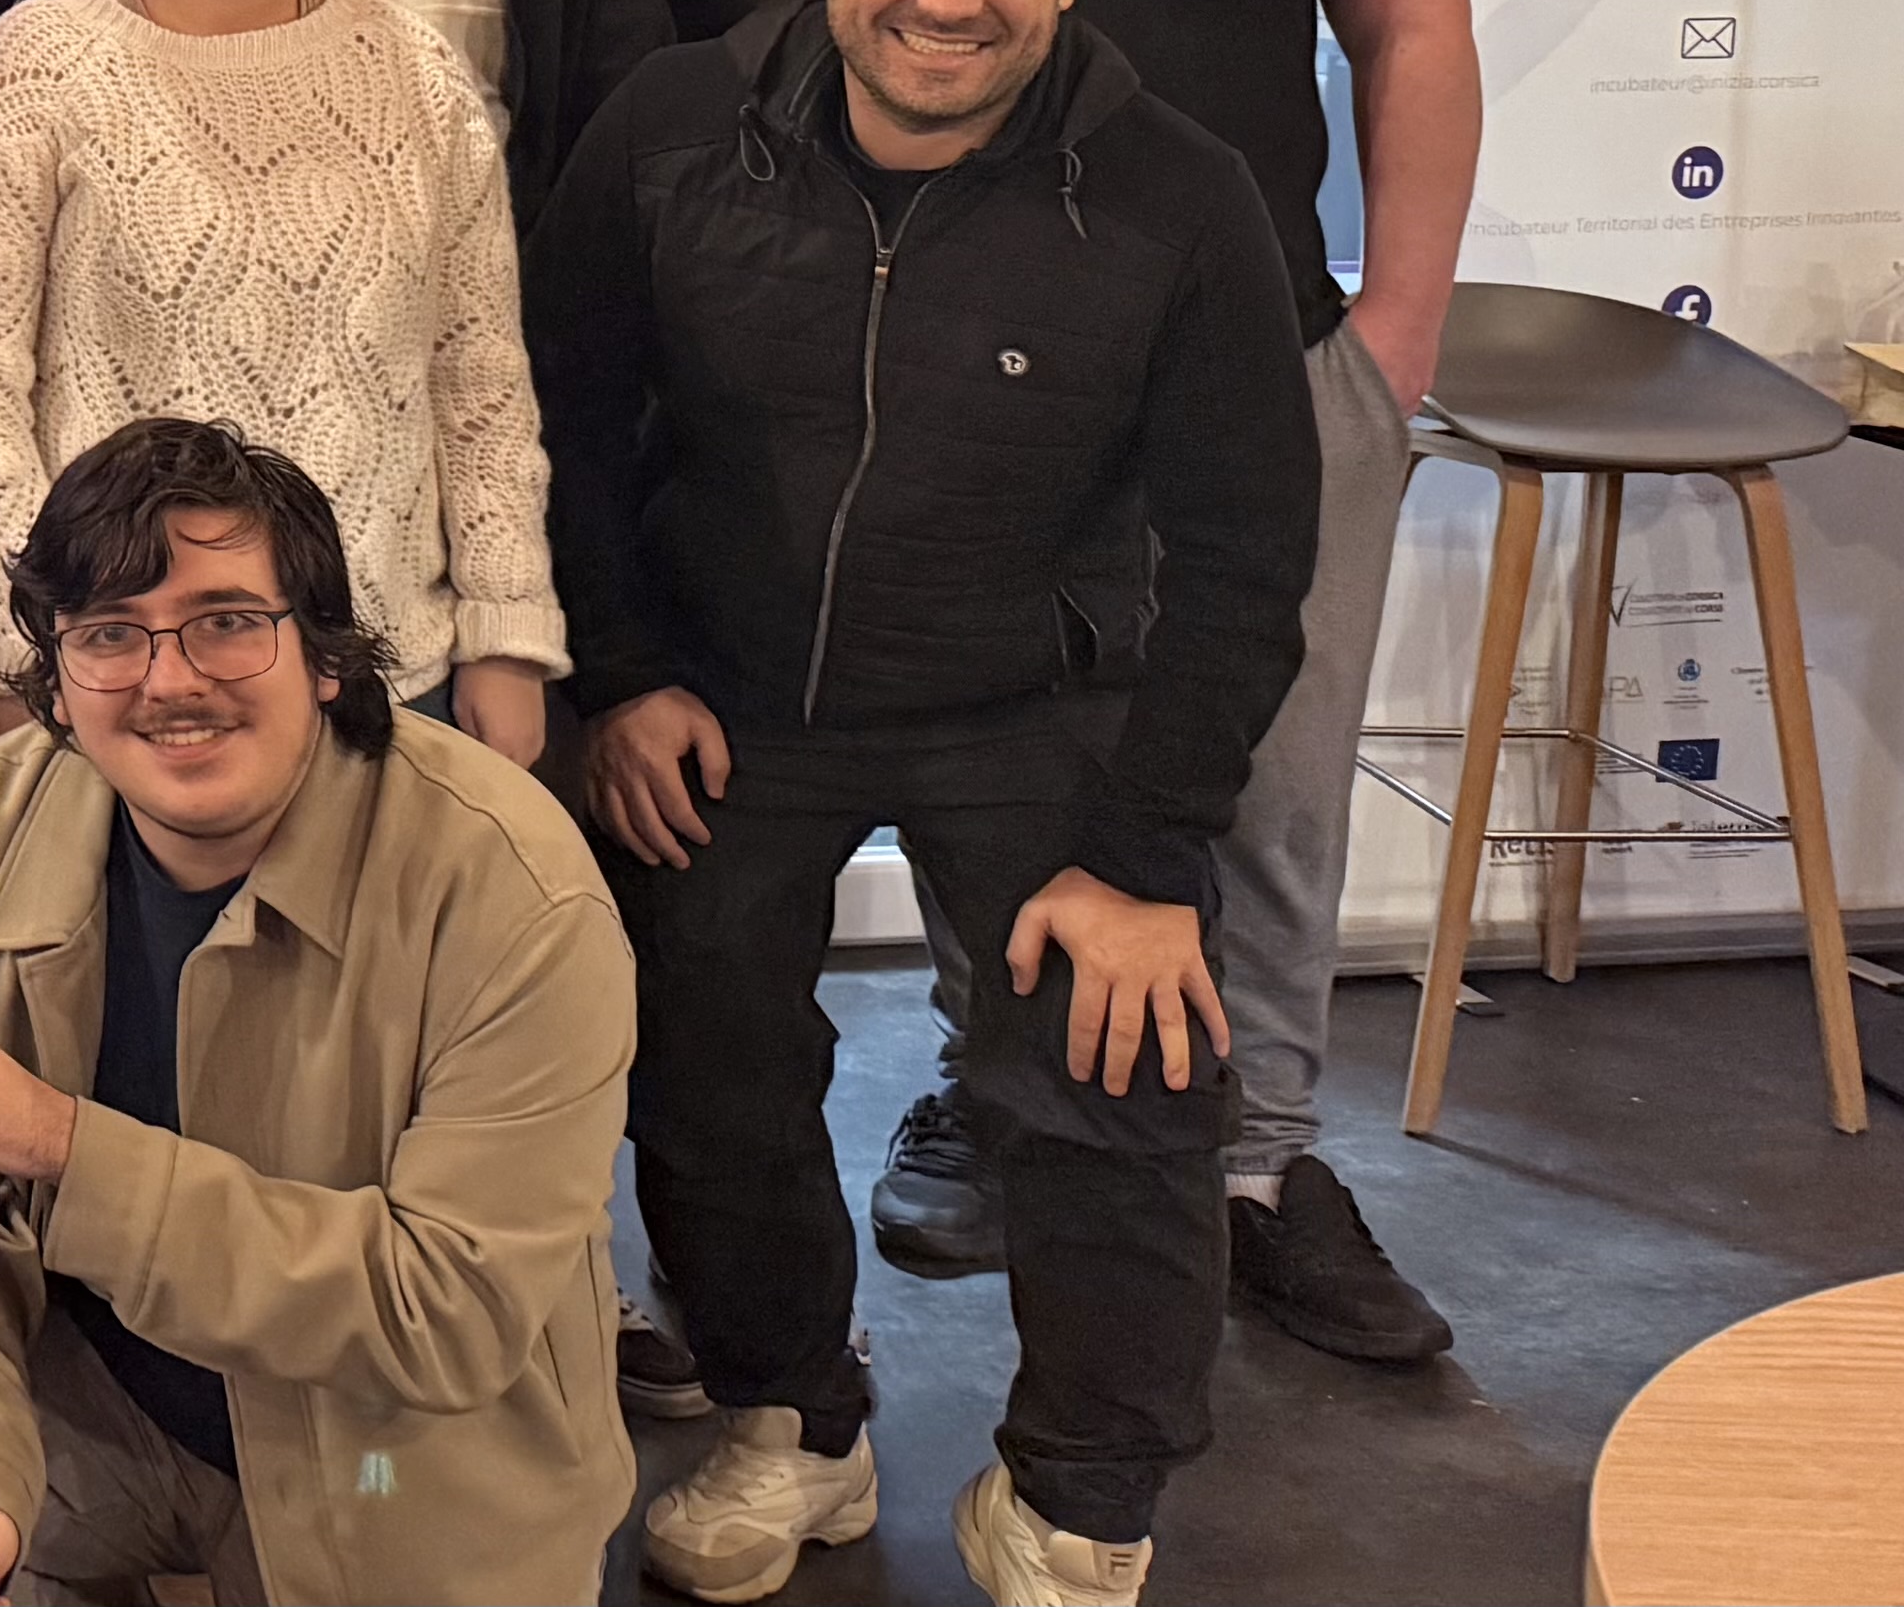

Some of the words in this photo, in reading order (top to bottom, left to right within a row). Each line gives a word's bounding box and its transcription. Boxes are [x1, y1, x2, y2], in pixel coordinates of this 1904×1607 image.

[1681, 157, 1714, 187] in
[1468, 218, 1569, 238] Incubateur
[1576, 215, 1658, 235] Territorial
[1663, 213, 1695, 232] des
[1700, 213, 1802, 230] Entreprises
